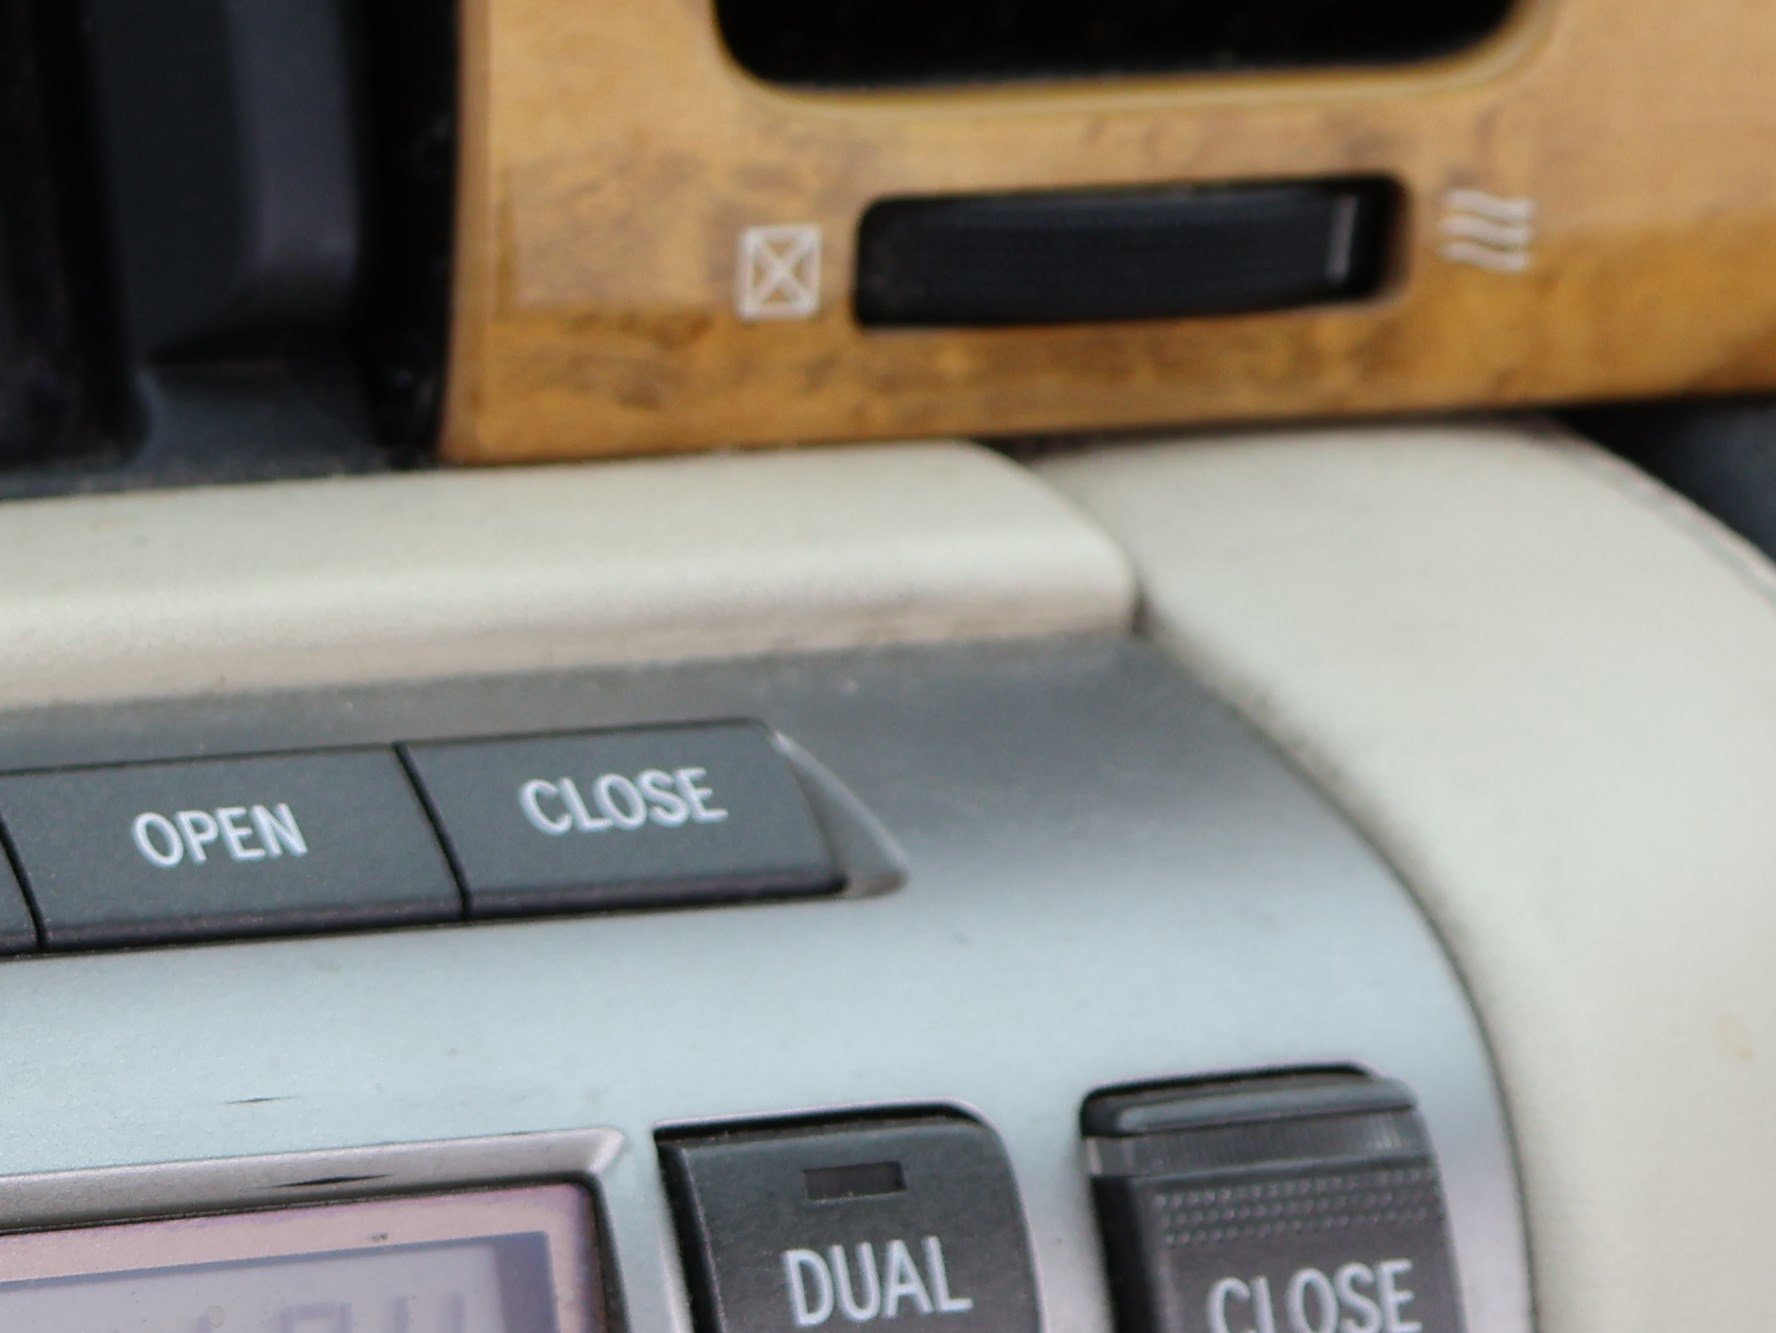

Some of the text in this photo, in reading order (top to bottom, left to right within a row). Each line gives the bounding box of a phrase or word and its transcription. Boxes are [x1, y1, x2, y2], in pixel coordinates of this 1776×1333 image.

[131, 803, 308, 870] OPEN
[519, 767, 730, 839] CLOSE
[782, 1236, 973, 1328] DUAL
